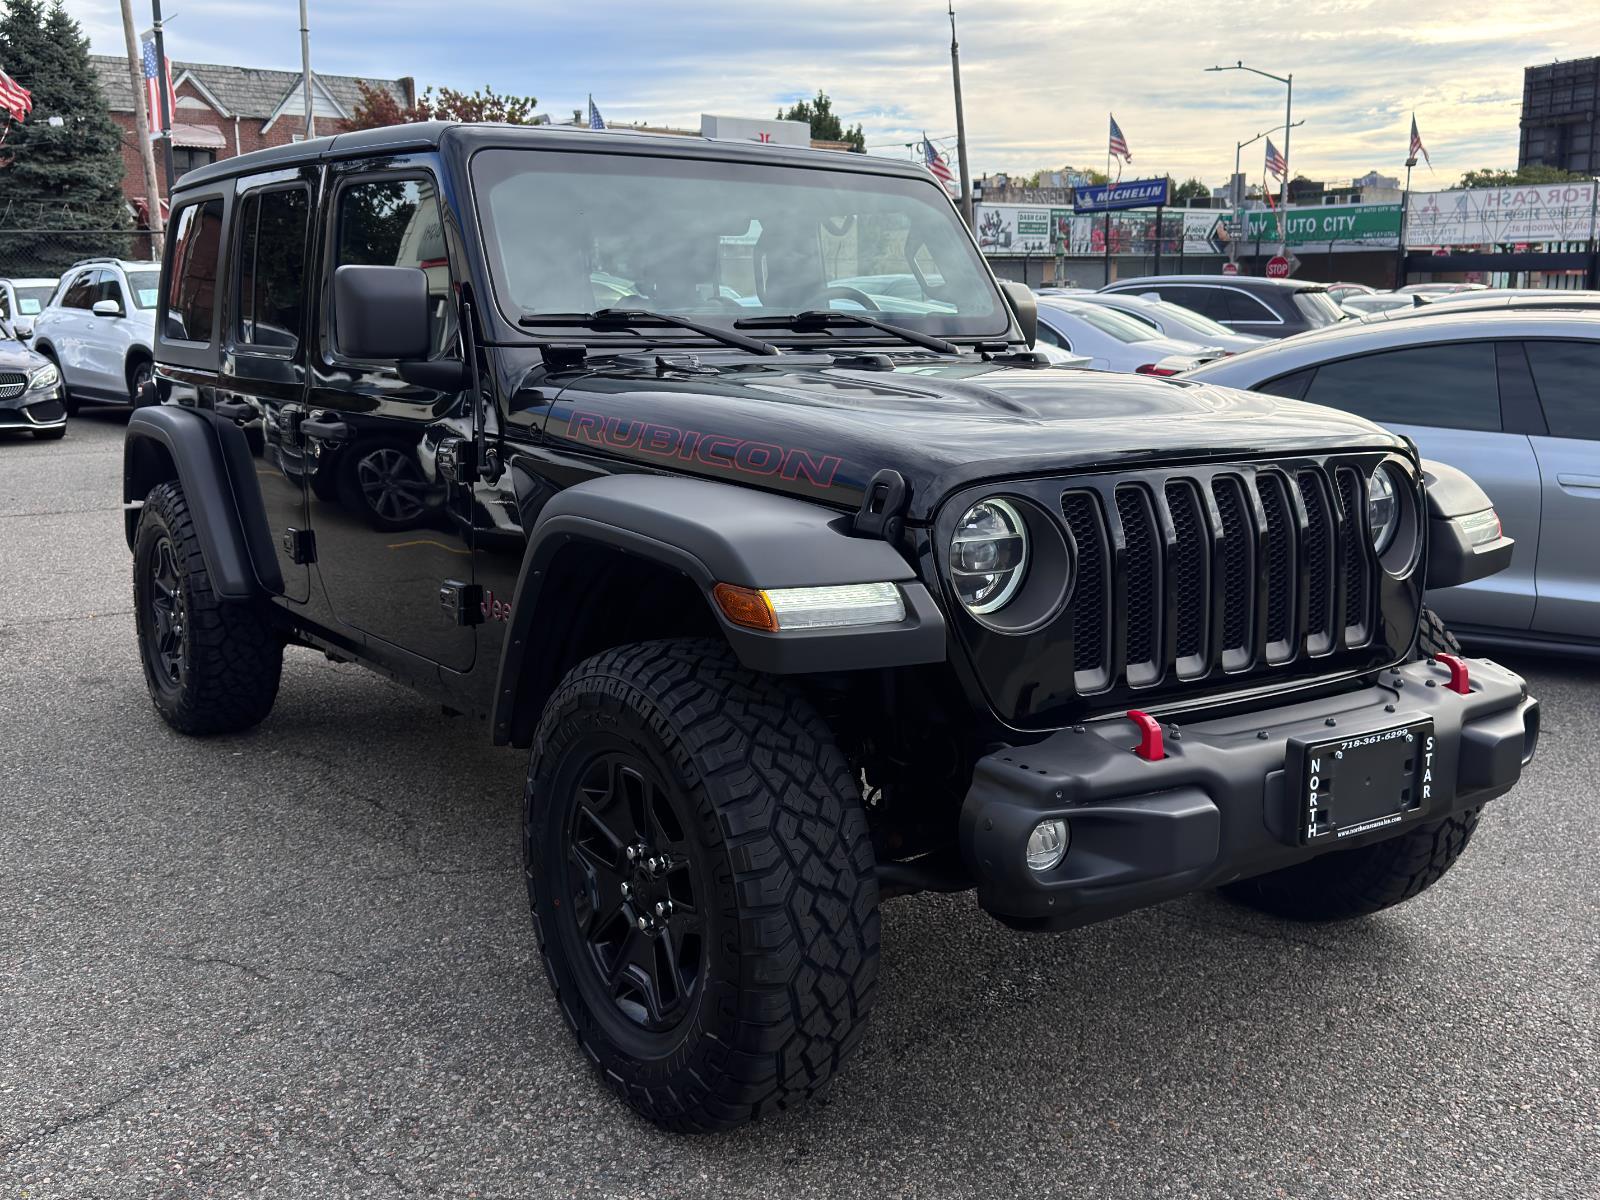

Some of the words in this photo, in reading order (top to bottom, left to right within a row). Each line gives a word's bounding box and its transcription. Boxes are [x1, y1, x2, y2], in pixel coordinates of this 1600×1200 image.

[1096, 186, 1162, 201] MICHELIN
[1248, 221, 1267, 236] NY
[1283, 218, 1317, 234] UTO
[1323, 215, 1356, 233] CITY
[1267, 263, 1288, 275] STOP
[566, 410, 842, 488] RUBICON
[480, 590, 512, 625] Jee
[1341, 728, 1408, 750] 718-361-6299
[1423, 736, 1434, 799] STAR
[1307, 758, 1321, 839] NORTH
